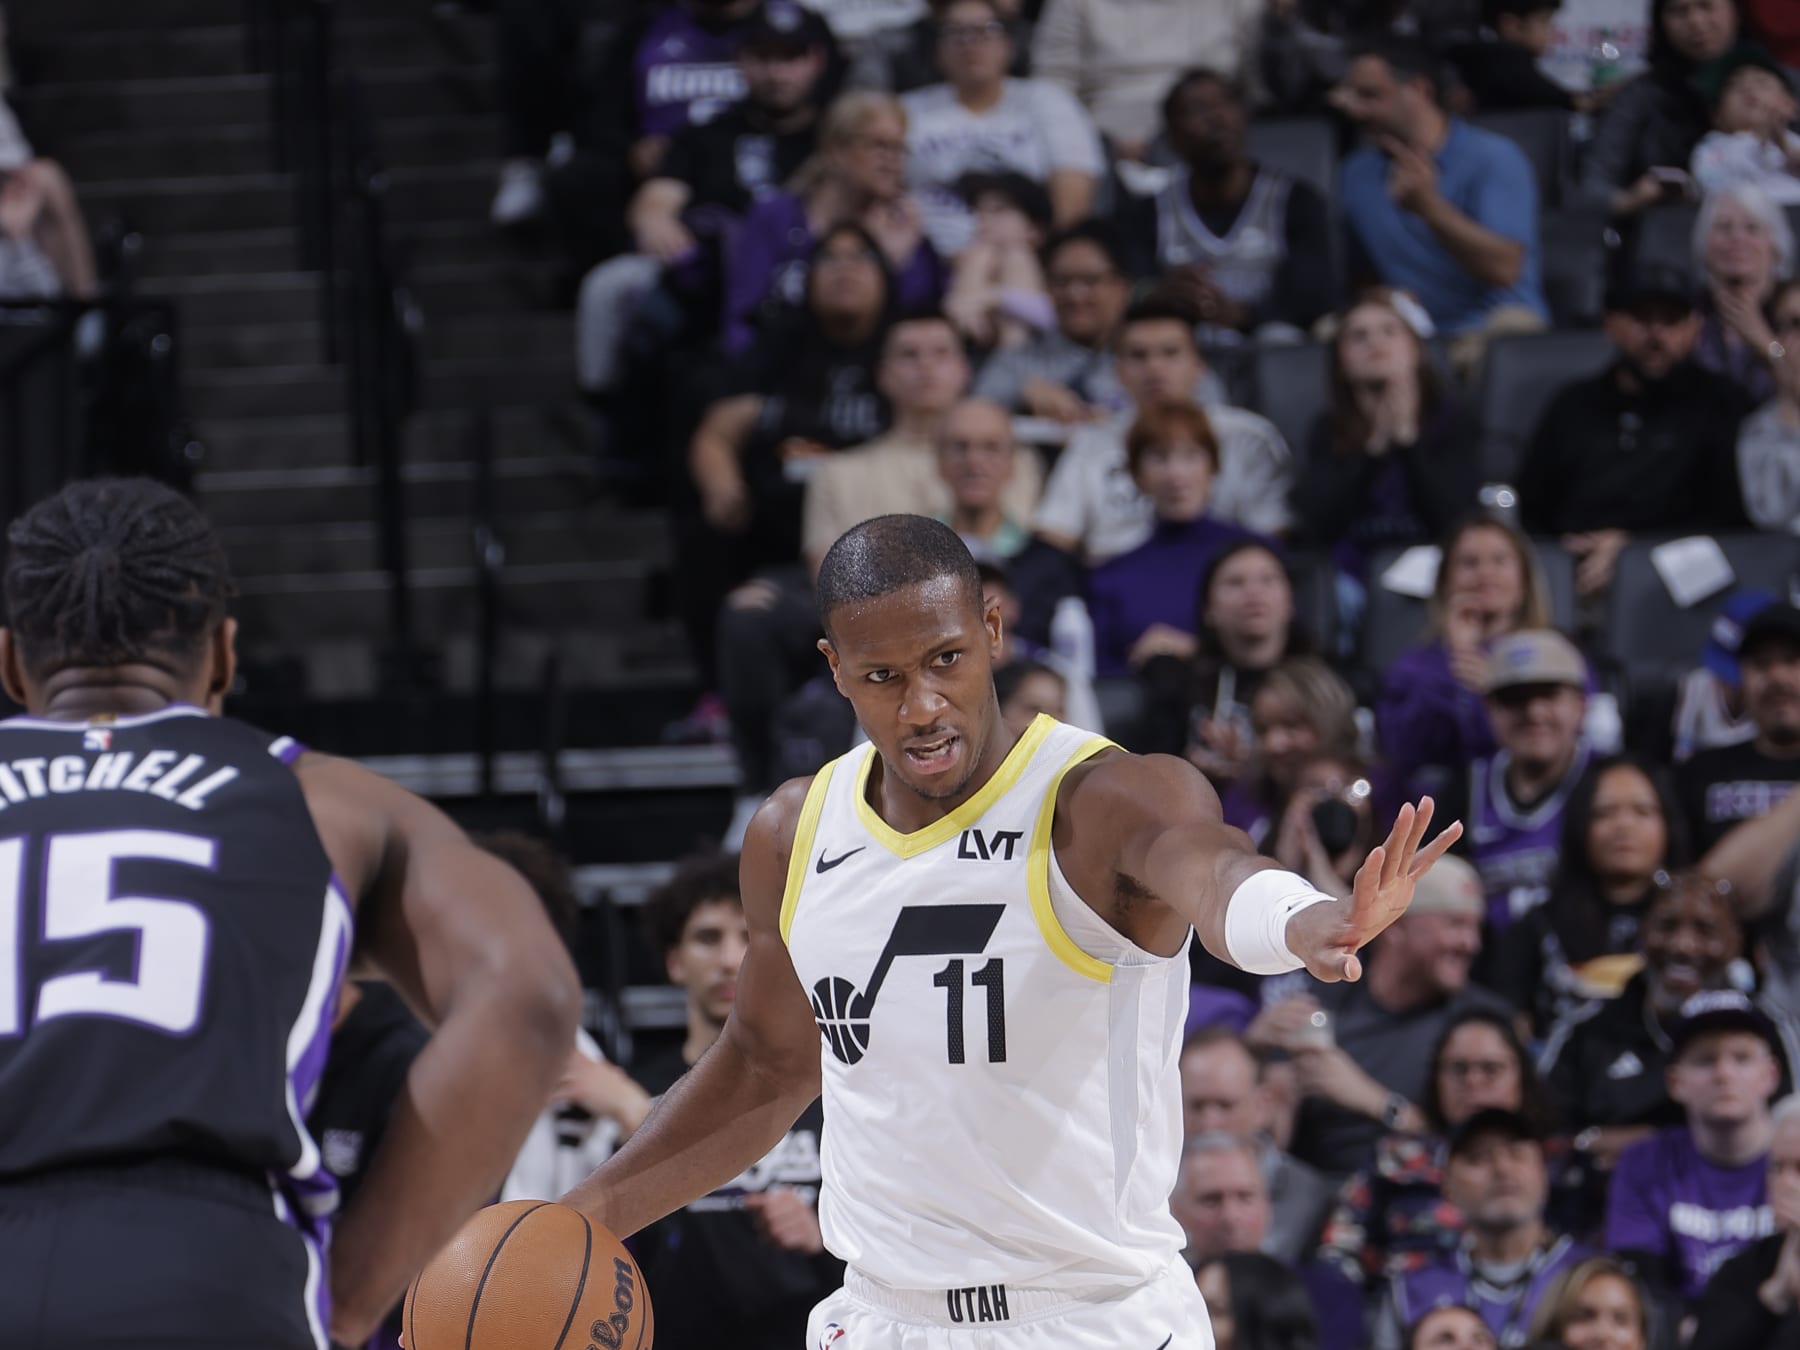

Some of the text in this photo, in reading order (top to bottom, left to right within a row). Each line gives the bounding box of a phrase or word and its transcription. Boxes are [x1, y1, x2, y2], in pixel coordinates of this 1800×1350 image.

[0, 749, 240, 812] ITCHELL
[957, 829, 1025, 861] LVT
[933, 957, 1007, 1064] 11
[946, 1283, 1010, 1323] UTAH
